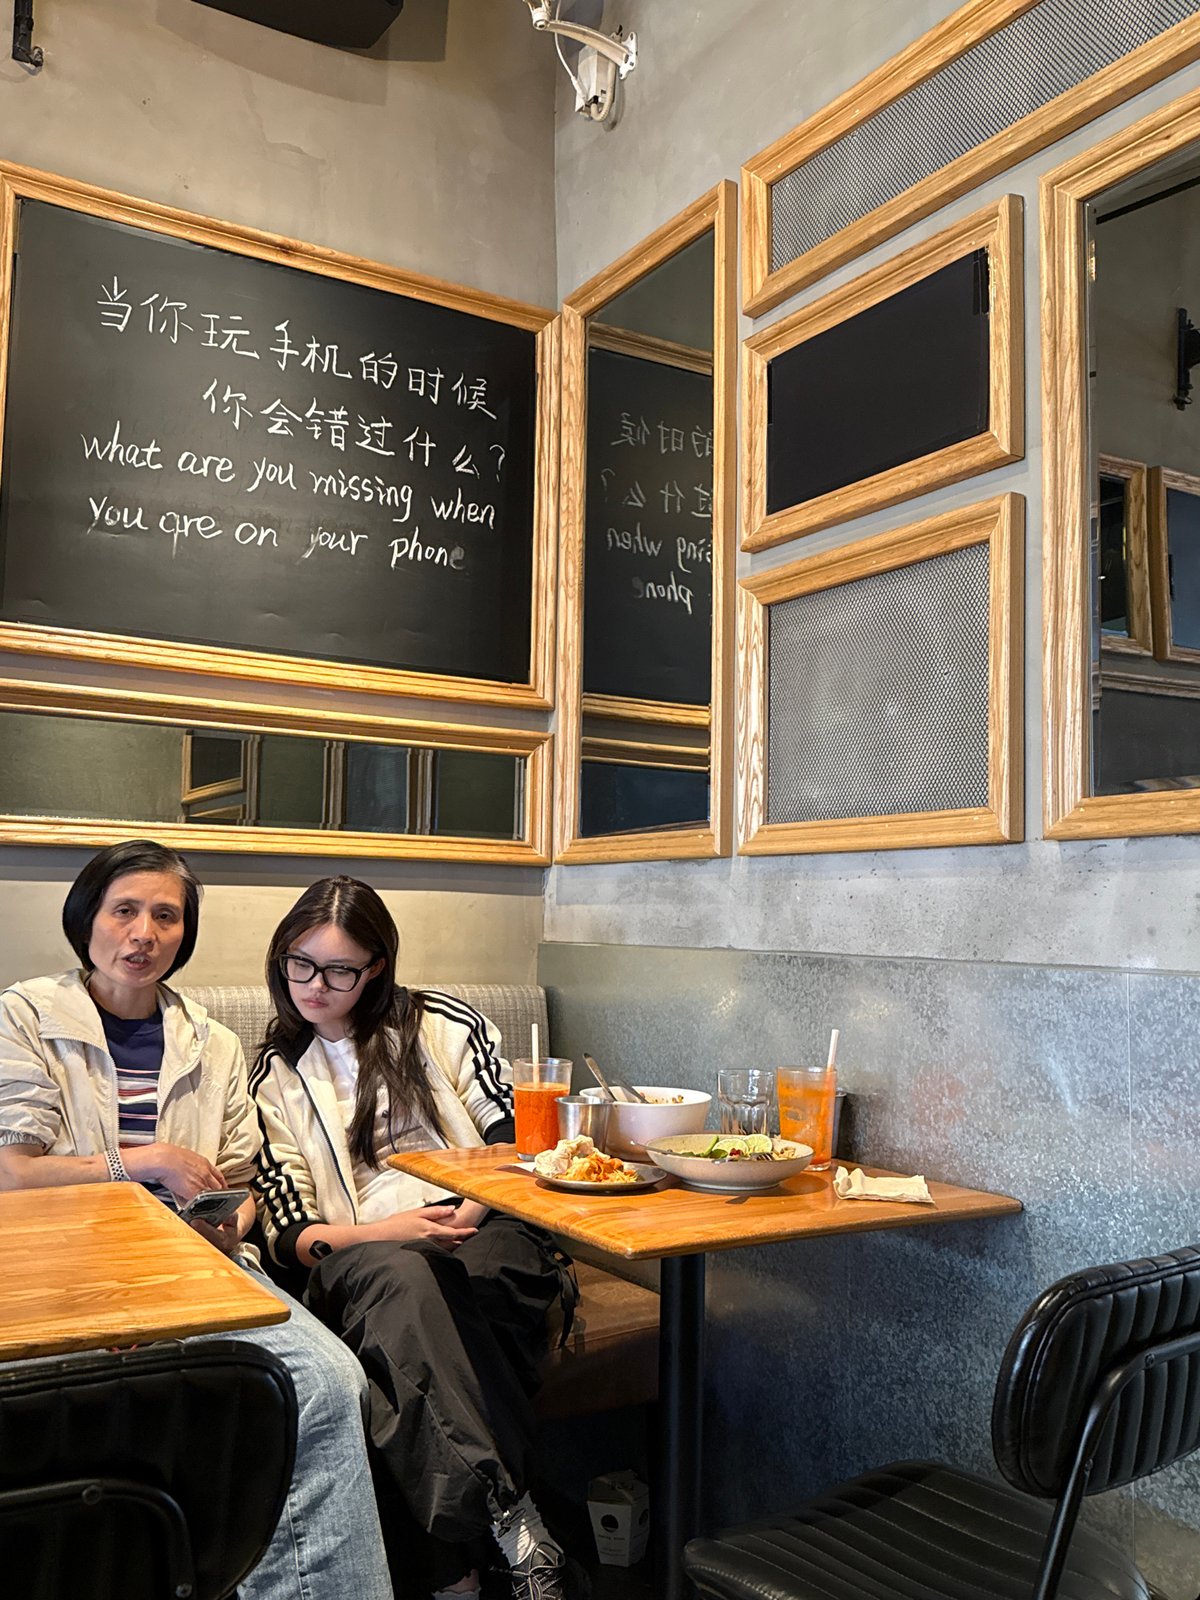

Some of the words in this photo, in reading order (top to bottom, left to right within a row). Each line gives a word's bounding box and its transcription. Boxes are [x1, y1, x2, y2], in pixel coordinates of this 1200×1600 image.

[97, 276, 498, 420] 当你玩手机的时候
[80, 420, 163, 470] what
[177, 450, 236, 483] are
[246, 456, 297, 493] you
[309, 470, 413, 523] missing
[430, 487, 497, 531] when
[87, 496, 149, 534] you
[235, 520, 279, 548] on
[296, 526, 369, 559] your
[388, 530, 466, 572] phone
